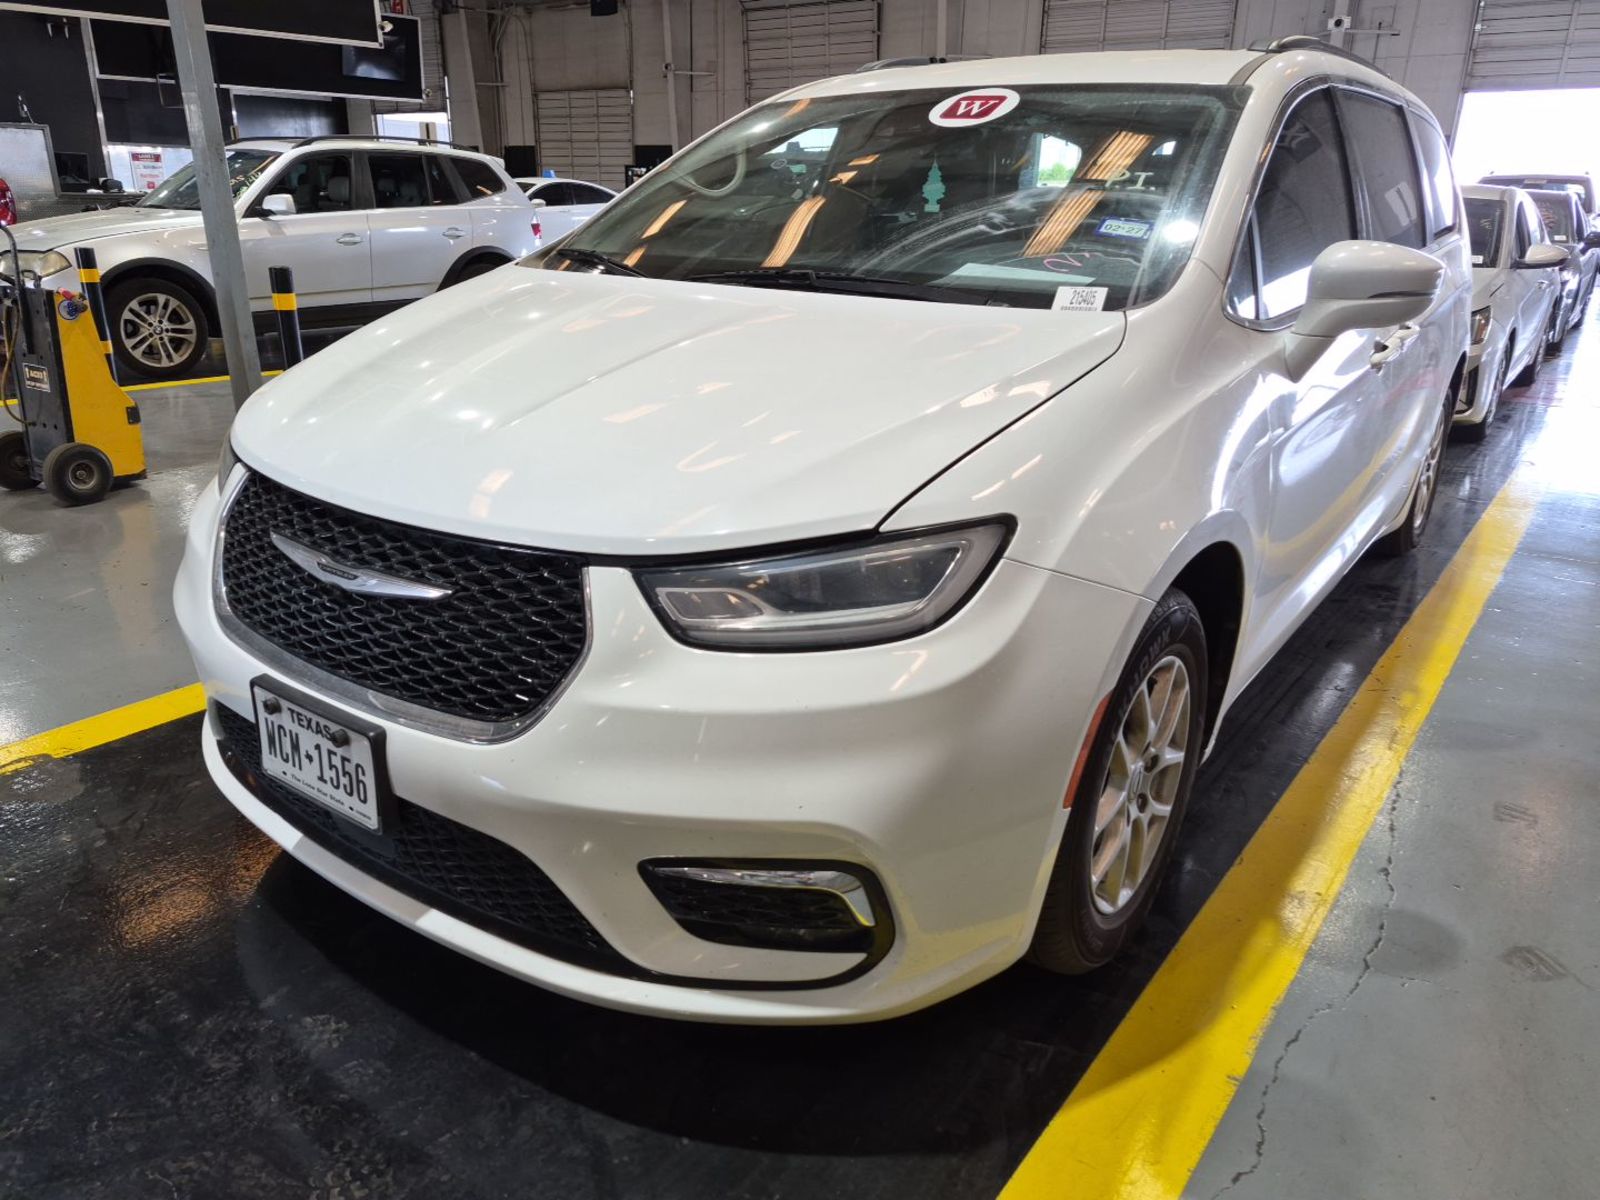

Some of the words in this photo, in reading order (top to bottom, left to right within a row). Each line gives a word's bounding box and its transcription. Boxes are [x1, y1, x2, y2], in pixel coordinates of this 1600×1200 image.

[957, 100, 999, 116] W
[1069, 290, 1098, 306] 215405
[287, 707, 334, 742] TEXAS
